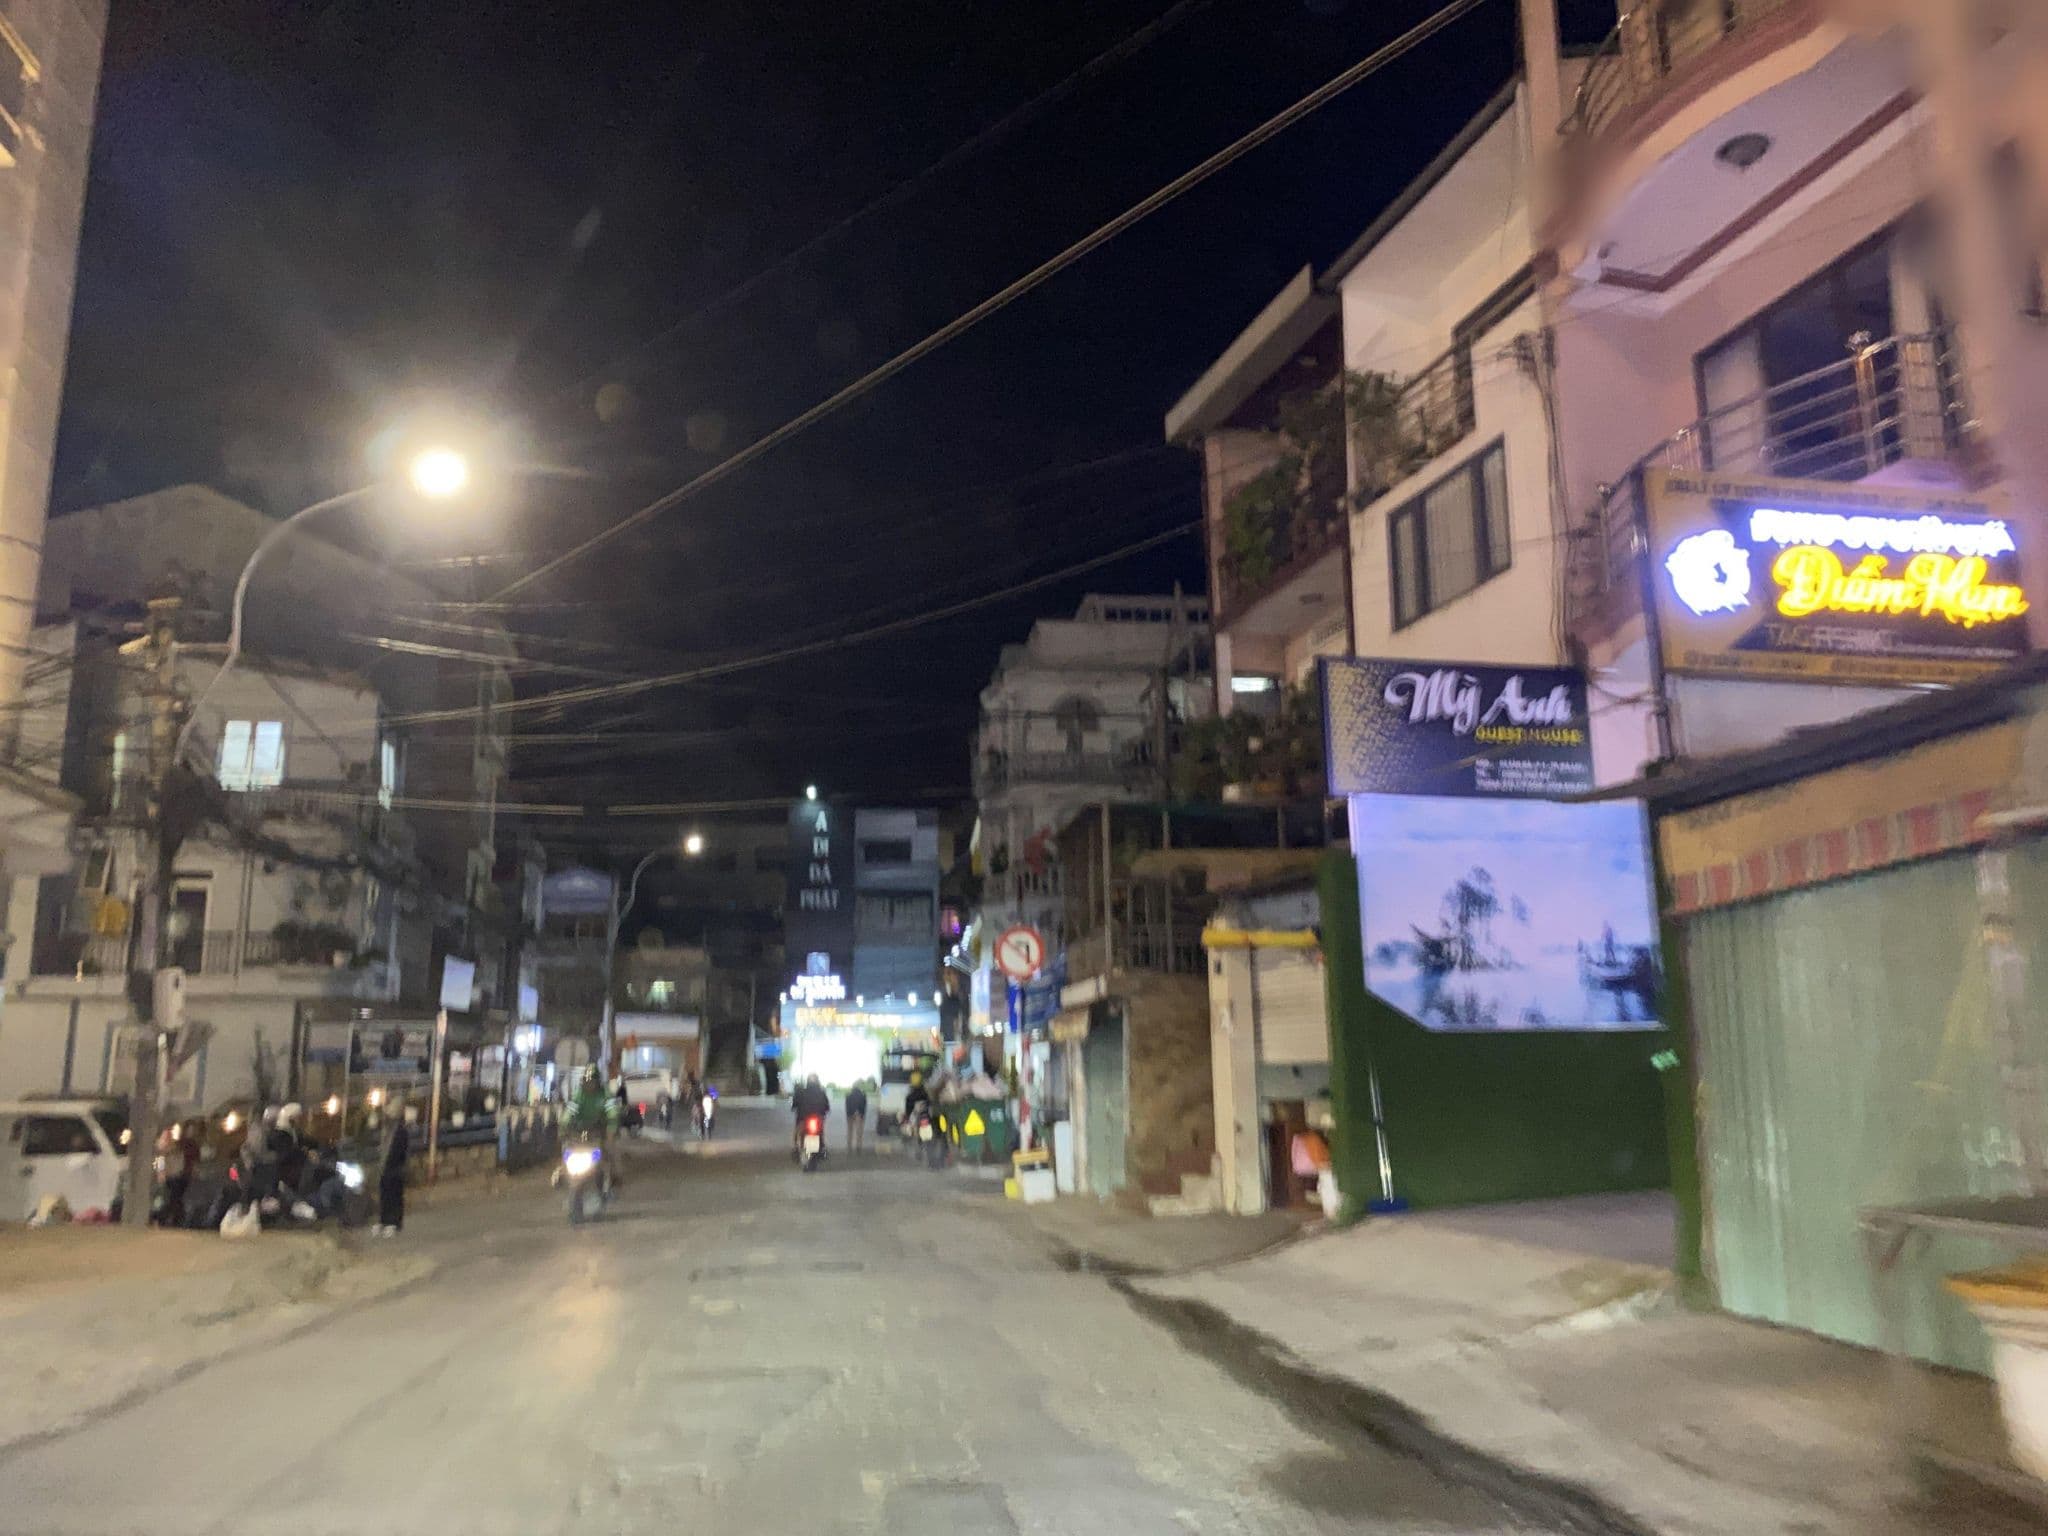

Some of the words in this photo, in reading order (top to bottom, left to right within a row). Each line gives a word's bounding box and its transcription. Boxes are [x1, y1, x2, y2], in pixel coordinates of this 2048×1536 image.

[1480, 674, 1573, 726] Anh
[1475, 725, 1522, 743] GUEST
[1525, 728, 1583, 746] HOUSE
